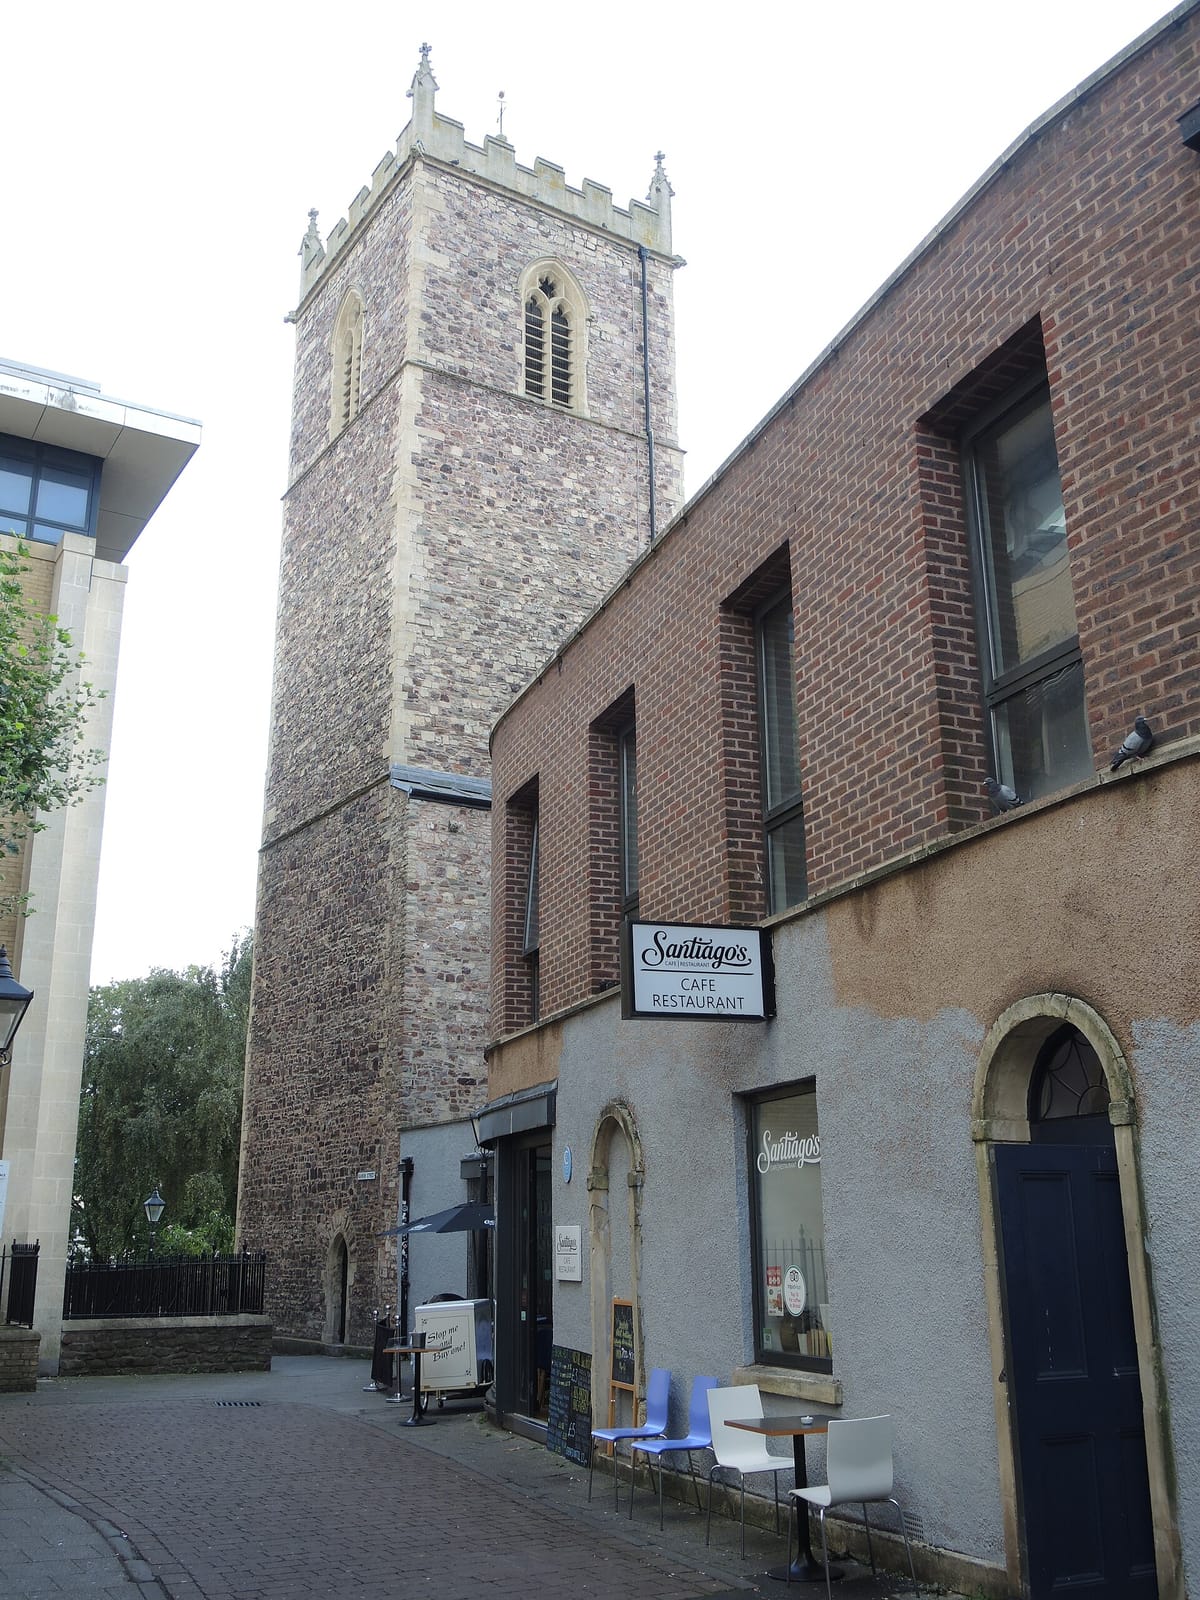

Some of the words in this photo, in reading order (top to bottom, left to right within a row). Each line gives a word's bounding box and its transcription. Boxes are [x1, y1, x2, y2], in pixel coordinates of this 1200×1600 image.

[641, 930, 752, 970] Santiago's
[680, 978, 716, 992] CAFE
[652, 994, 745, 1010] RESTAURANT
[757, 1130, 821, 1174] Santiago's
[427, 1331, 447, 1344] Stop
[432, 1350, 450, 1362] Buy
